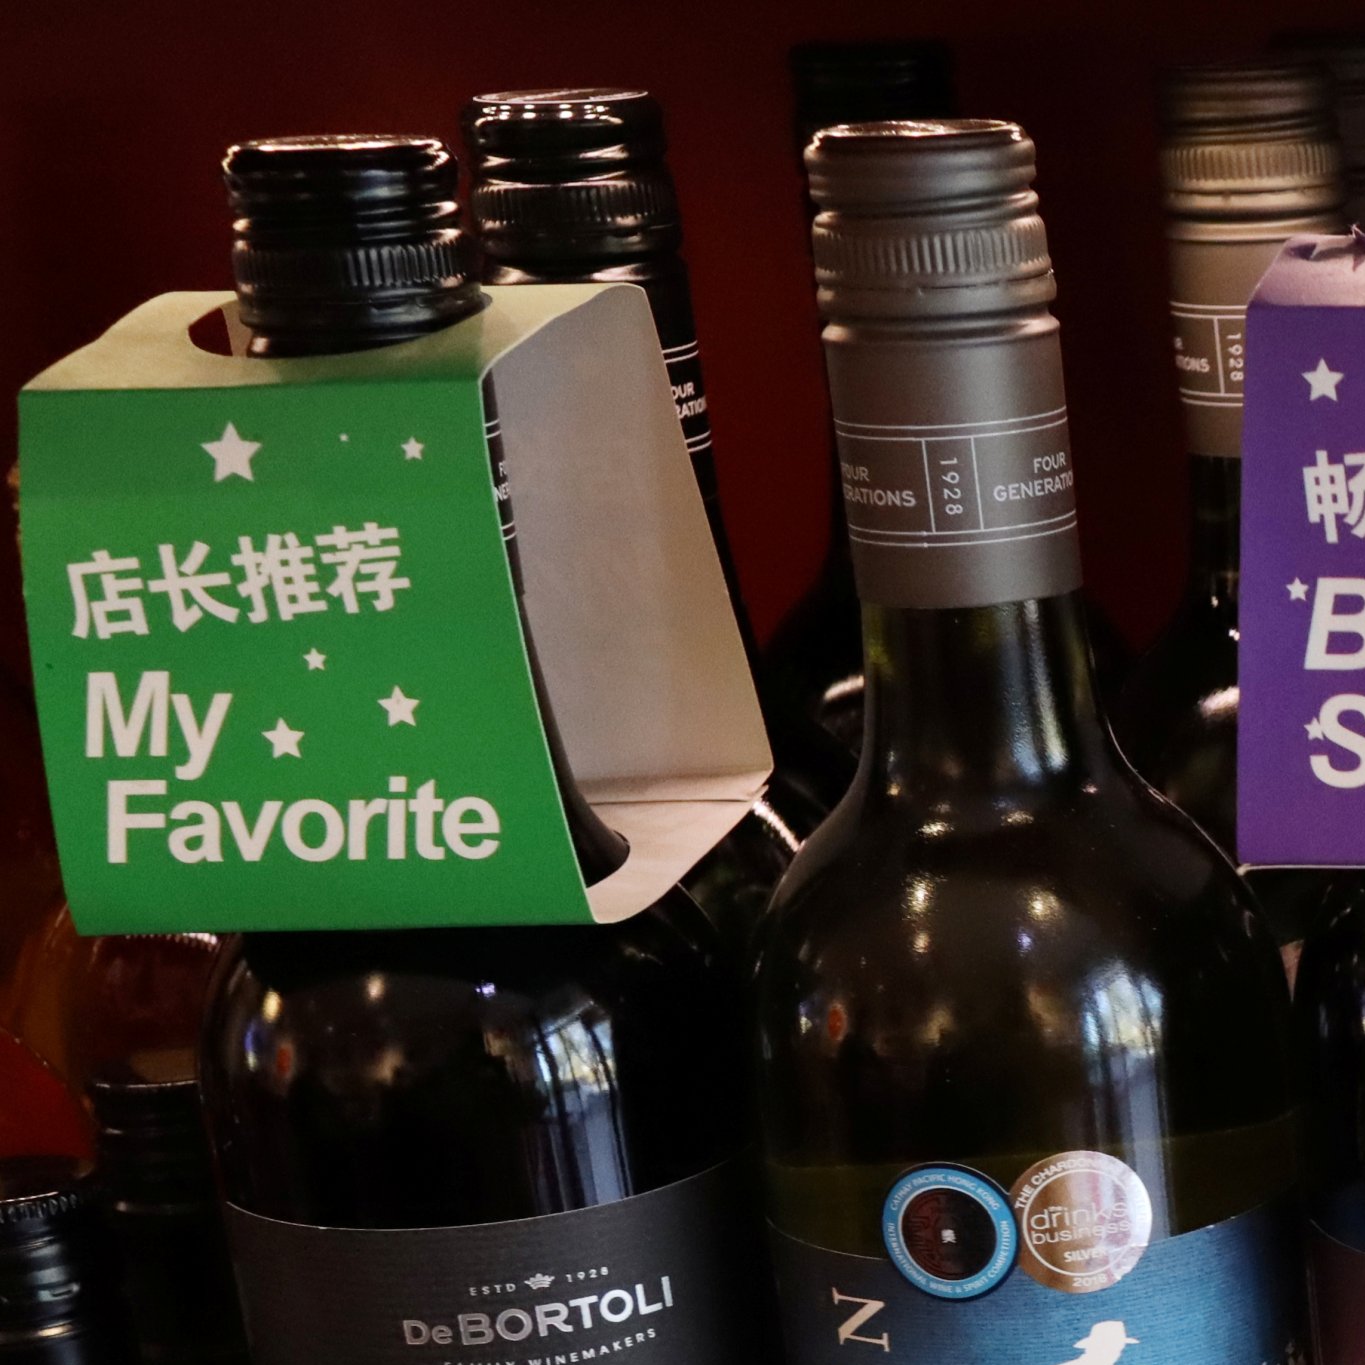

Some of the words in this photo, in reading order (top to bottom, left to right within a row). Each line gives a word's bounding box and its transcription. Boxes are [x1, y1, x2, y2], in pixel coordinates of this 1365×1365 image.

[939, 457, 963, 516] 1928
[1033, 452, 1066, 474] FOUR
[66, 522, 411, 640] 店长推荐
[85, 670, 233, 781] My
[106, 777, 501, 864] Favorite
[1032, 1219, 1131, 1245] business
[470, 1282, 517, 1297] ESTD
[566, 1266, 609, 1284] 1928
